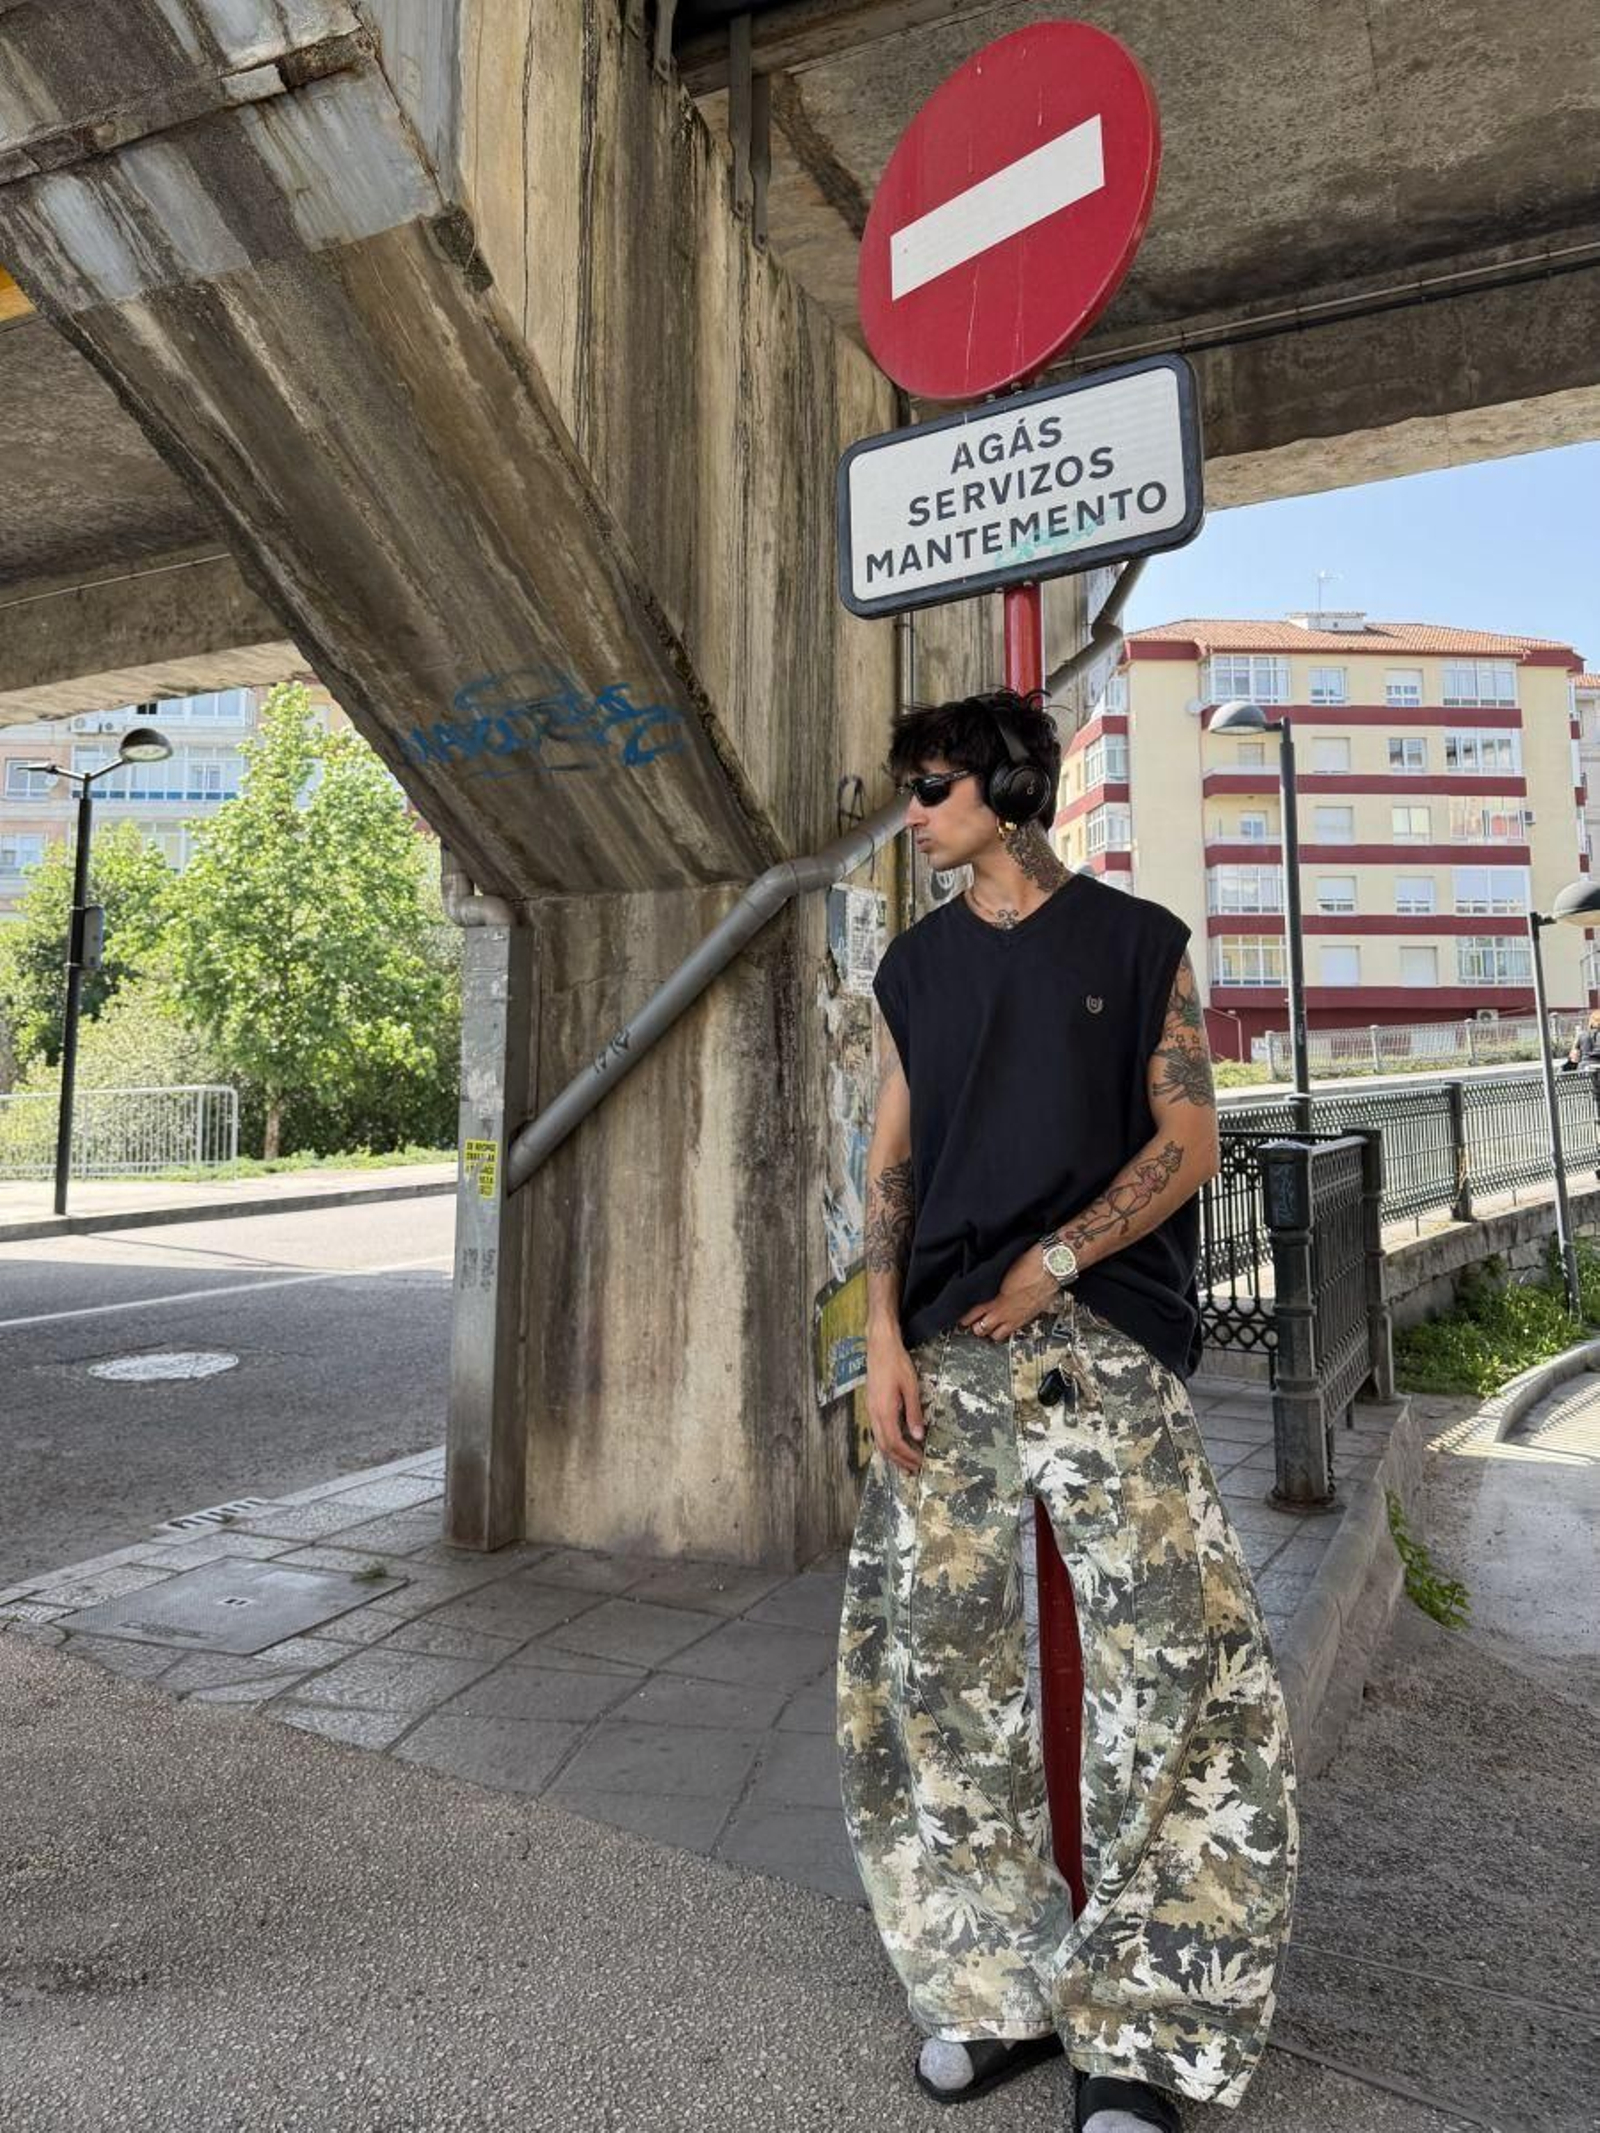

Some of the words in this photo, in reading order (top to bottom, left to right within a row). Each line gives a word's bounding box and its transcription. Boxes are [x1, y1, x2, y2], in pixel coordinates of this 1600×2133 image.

[950, 417, 1063, 474] AGÁS
[908, 447, 1115, 527] SERVIZOS
[865, 481, 1168, 583] MANTEMENTO
